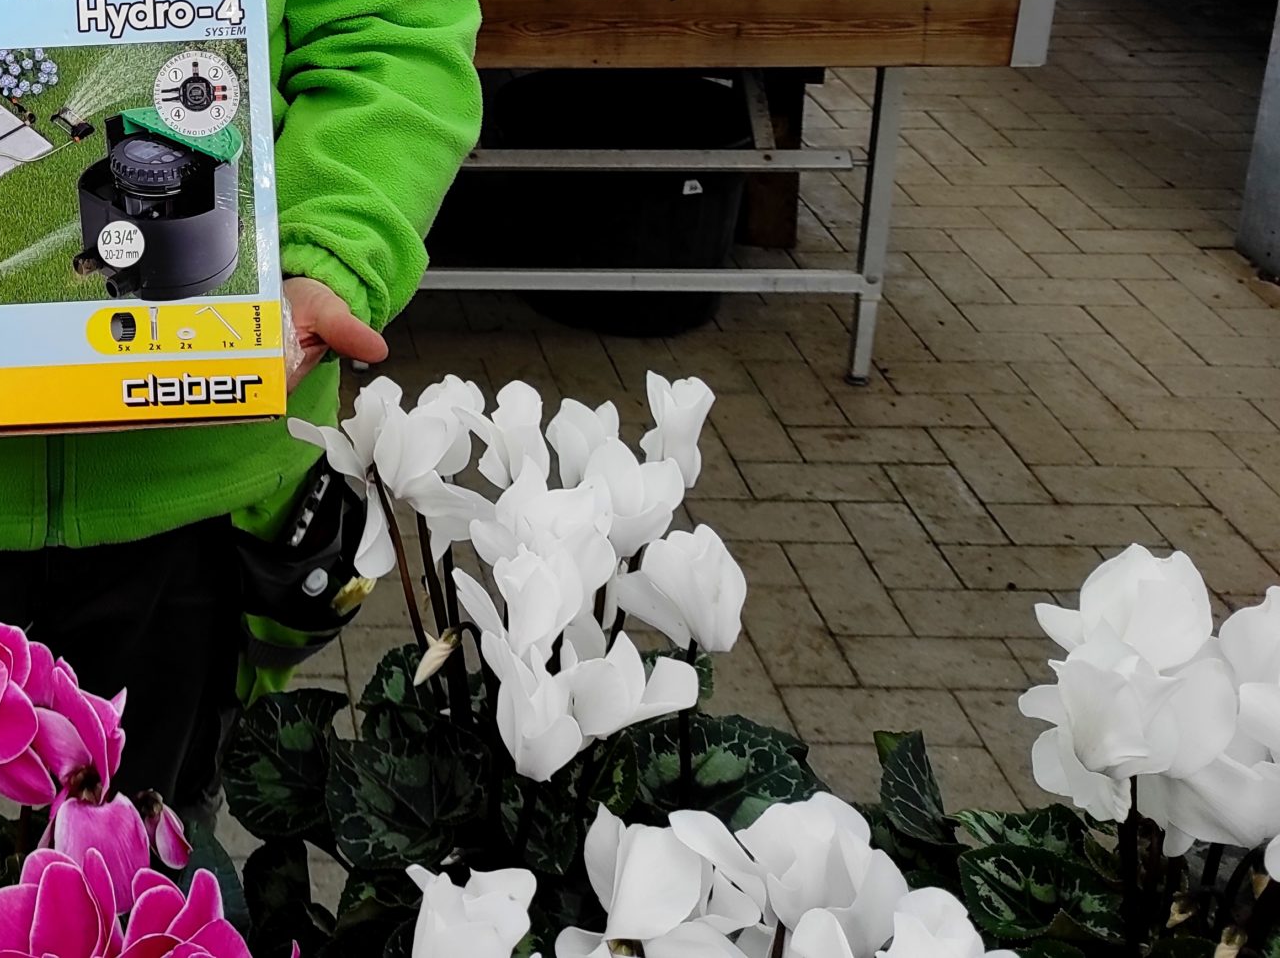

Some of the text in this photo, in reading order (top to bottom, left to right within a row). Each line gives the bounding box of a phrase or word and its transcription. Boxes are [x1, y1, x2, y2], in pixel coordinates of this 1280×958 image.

[205, 26, 247, 37] SYSTEM
[160, 52, 191, 77] OPERATED
[200, 53, 237, 82] ELECTRONIC
[212, 68, 219, 78] 2
[174, 109, 181, 119] 4
[214, 107, 221, 117] 3
[170, 121, 206, 135] SOLENOID
[208, 114, 231, 133] VALVES
[105, 249, 140, 260] 20-27 mm
[253, 305, 261, 347] included
[122, 372, 263, 408] claber
